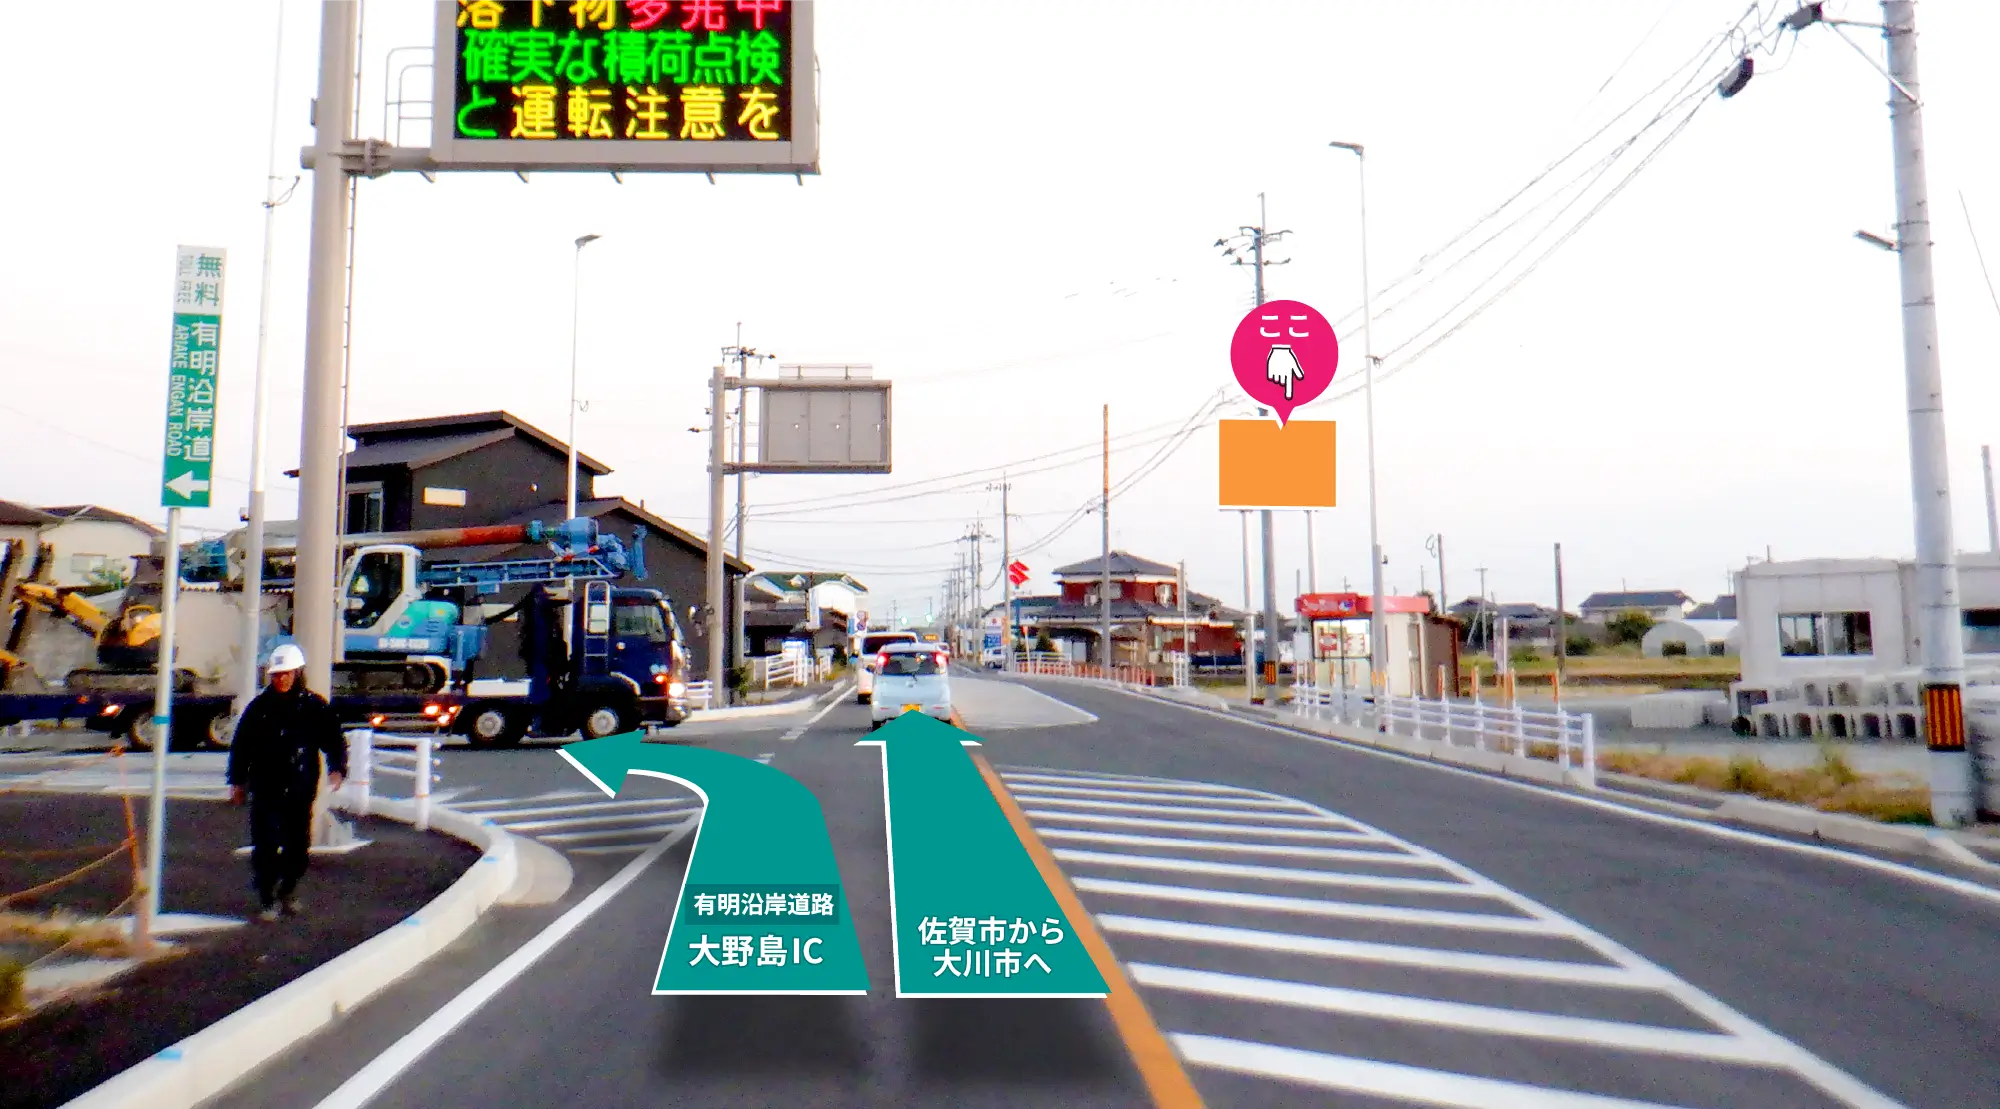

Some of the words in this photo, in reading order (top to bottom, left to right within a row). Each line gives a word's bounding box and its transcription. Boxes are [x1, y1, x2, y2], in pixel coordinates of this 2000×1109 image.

[462, 29, 782, 84] 確実な積荷点検
[457, 85, 780, 139] と運転注意を
[176, 280, 191, 304] FREE
[194, 253, 222, 306] 無料
[173, 324, 190, 368] ARIAKE
[169, 374, 187, 417] ENGAN
[182, 321, 219, 462] 有明沿岸道
[166, 422, 183, 457] ROAD
